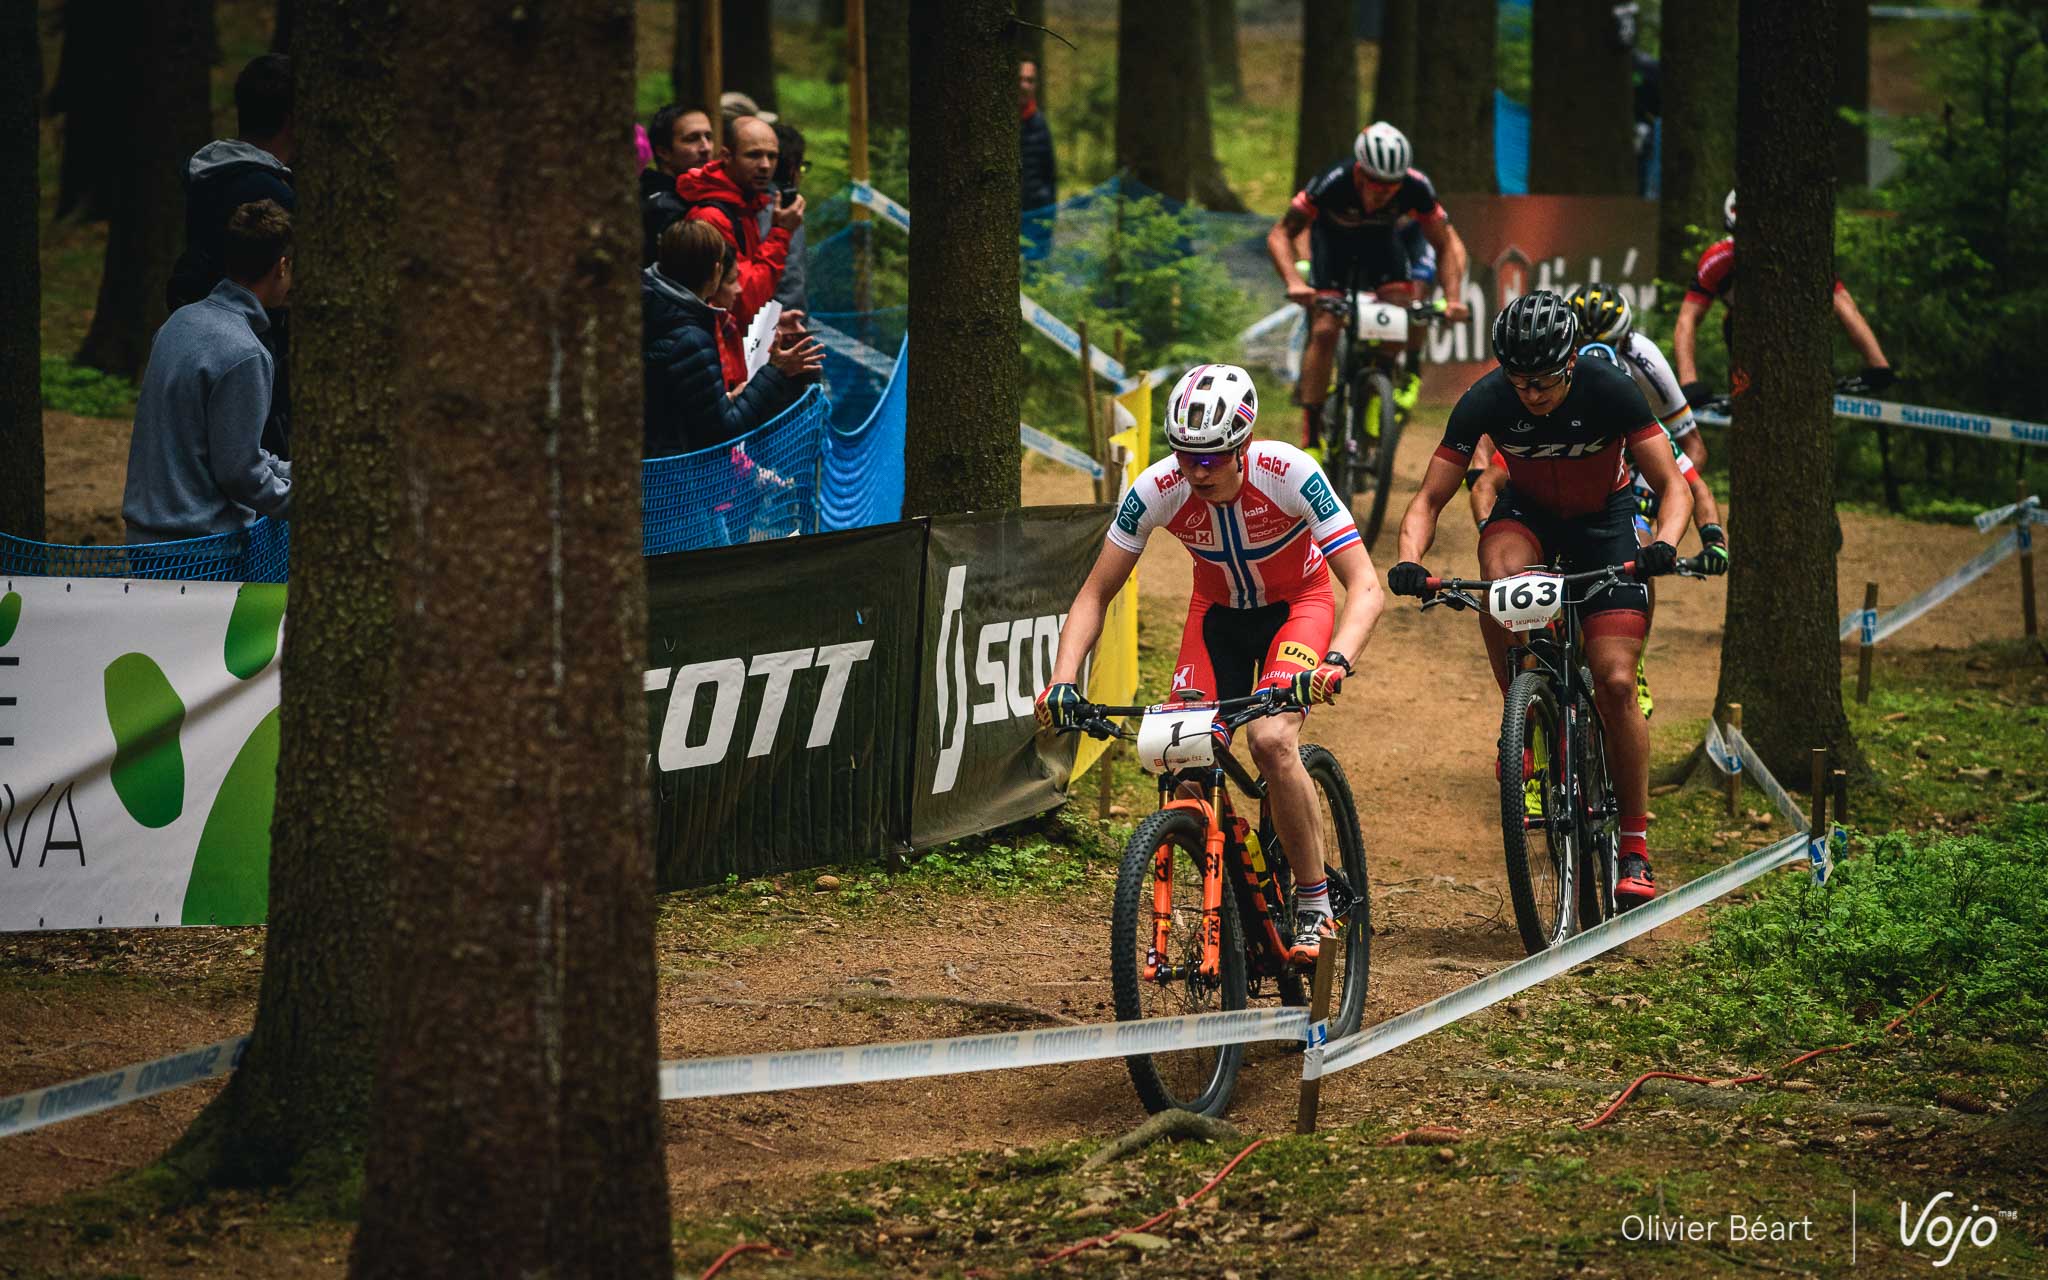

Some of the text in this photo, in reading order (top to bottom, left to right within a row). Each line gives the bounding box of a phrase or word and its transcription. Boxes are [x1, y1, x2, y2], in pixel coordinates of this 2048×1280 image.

[1377, 308, 1390, 326] 6
[1256, 452, 1290, 477] kalas
[1307, 479, 1334, 515] DNB
[1120, 496, 1139, 530] DNB
[1244, 504, 1268, 518] kalas
[1176, 532, 1194, 540] Uno
[1494, 582, 1557, 612] 163
[1284, 646, 1315, 667] Uno
[643, 640, 875, 772] OTT
[1170, 721, 1185, 747] 1
